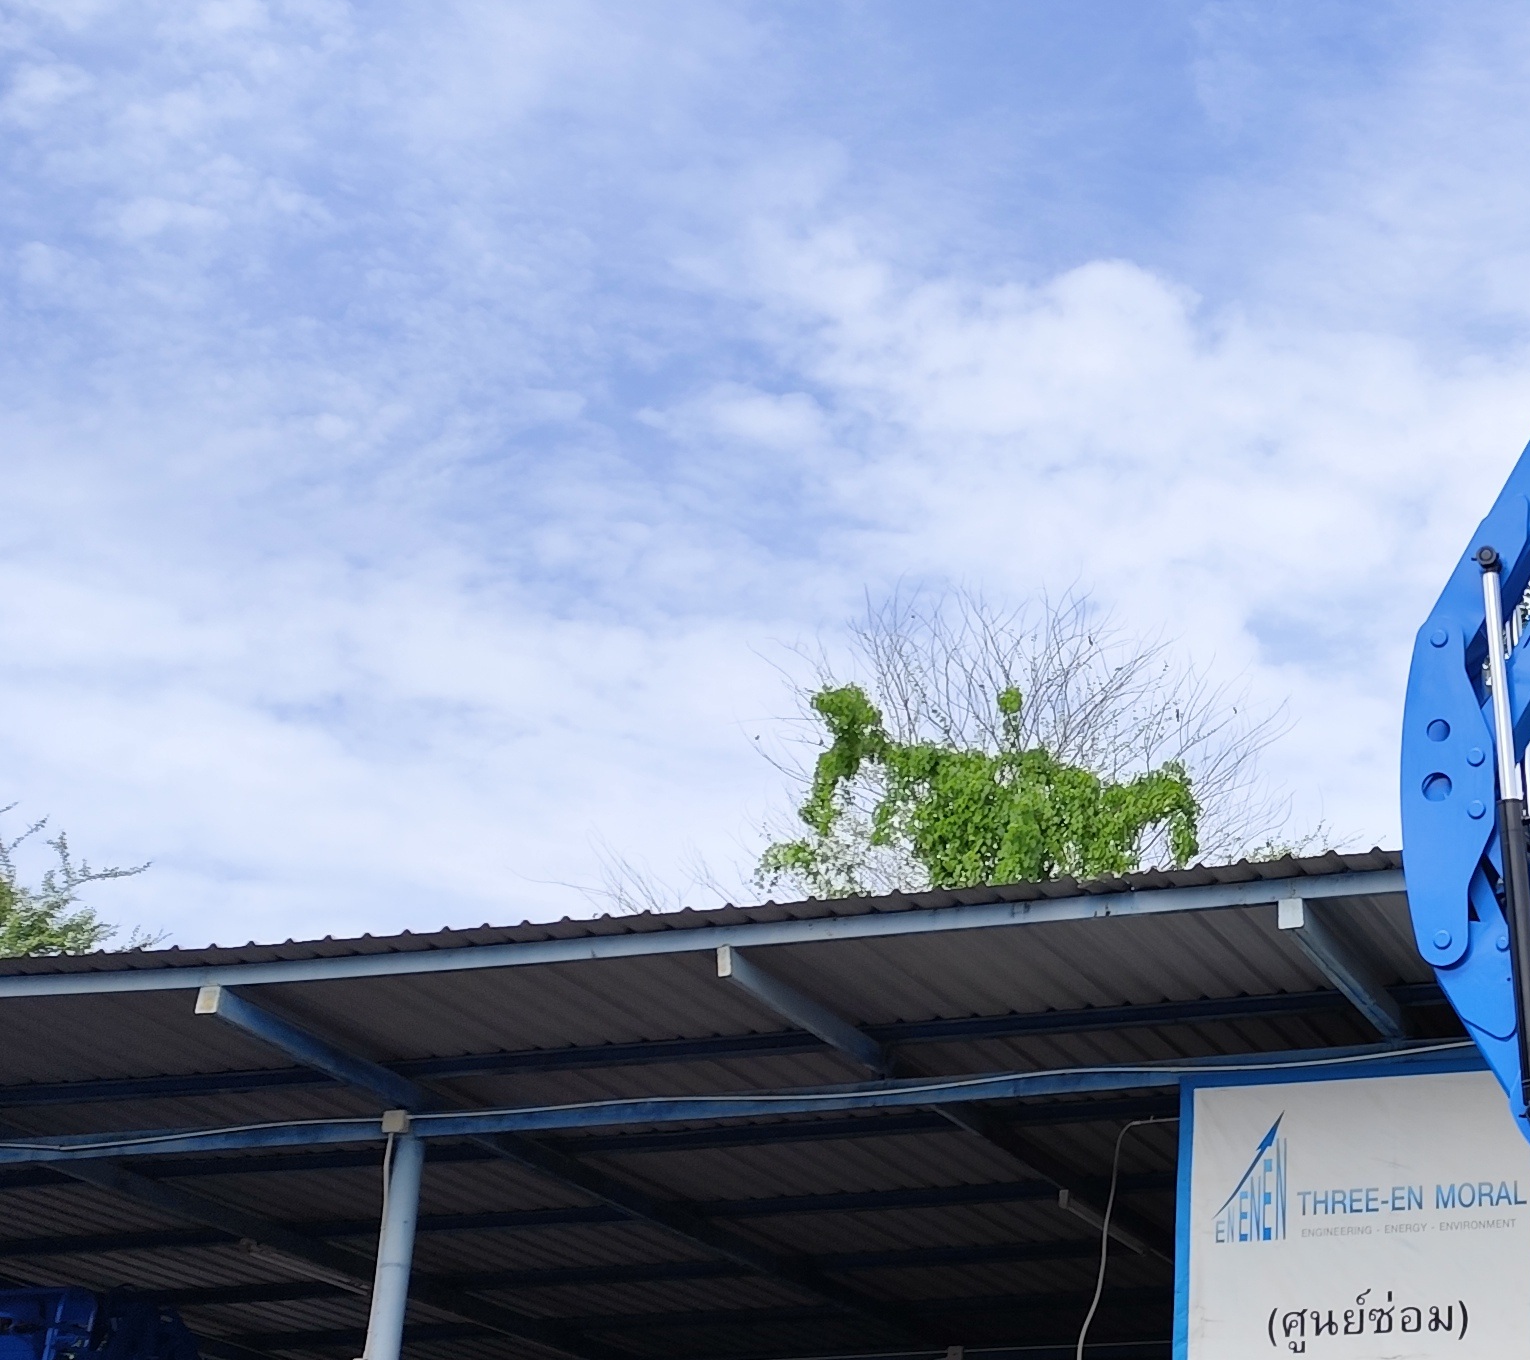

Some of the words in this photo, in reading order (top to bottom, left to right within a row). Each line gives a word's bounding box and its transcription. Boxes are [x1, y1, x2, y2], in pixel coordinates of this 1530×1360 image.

[1297, 1184, 1424, 1217] THREE-EN
[1435, 1180, 1528, 1210] MORAL
[1301, 1225, 1373, 1238] ENGINEERING
[1384, 1223, 1428, 1235] ENERGY
[1439, 1218, 1517, 1232] ENVIRONMENT
[1267, 1288, 1469, 1354] (ศูนย์ซ่อม)
